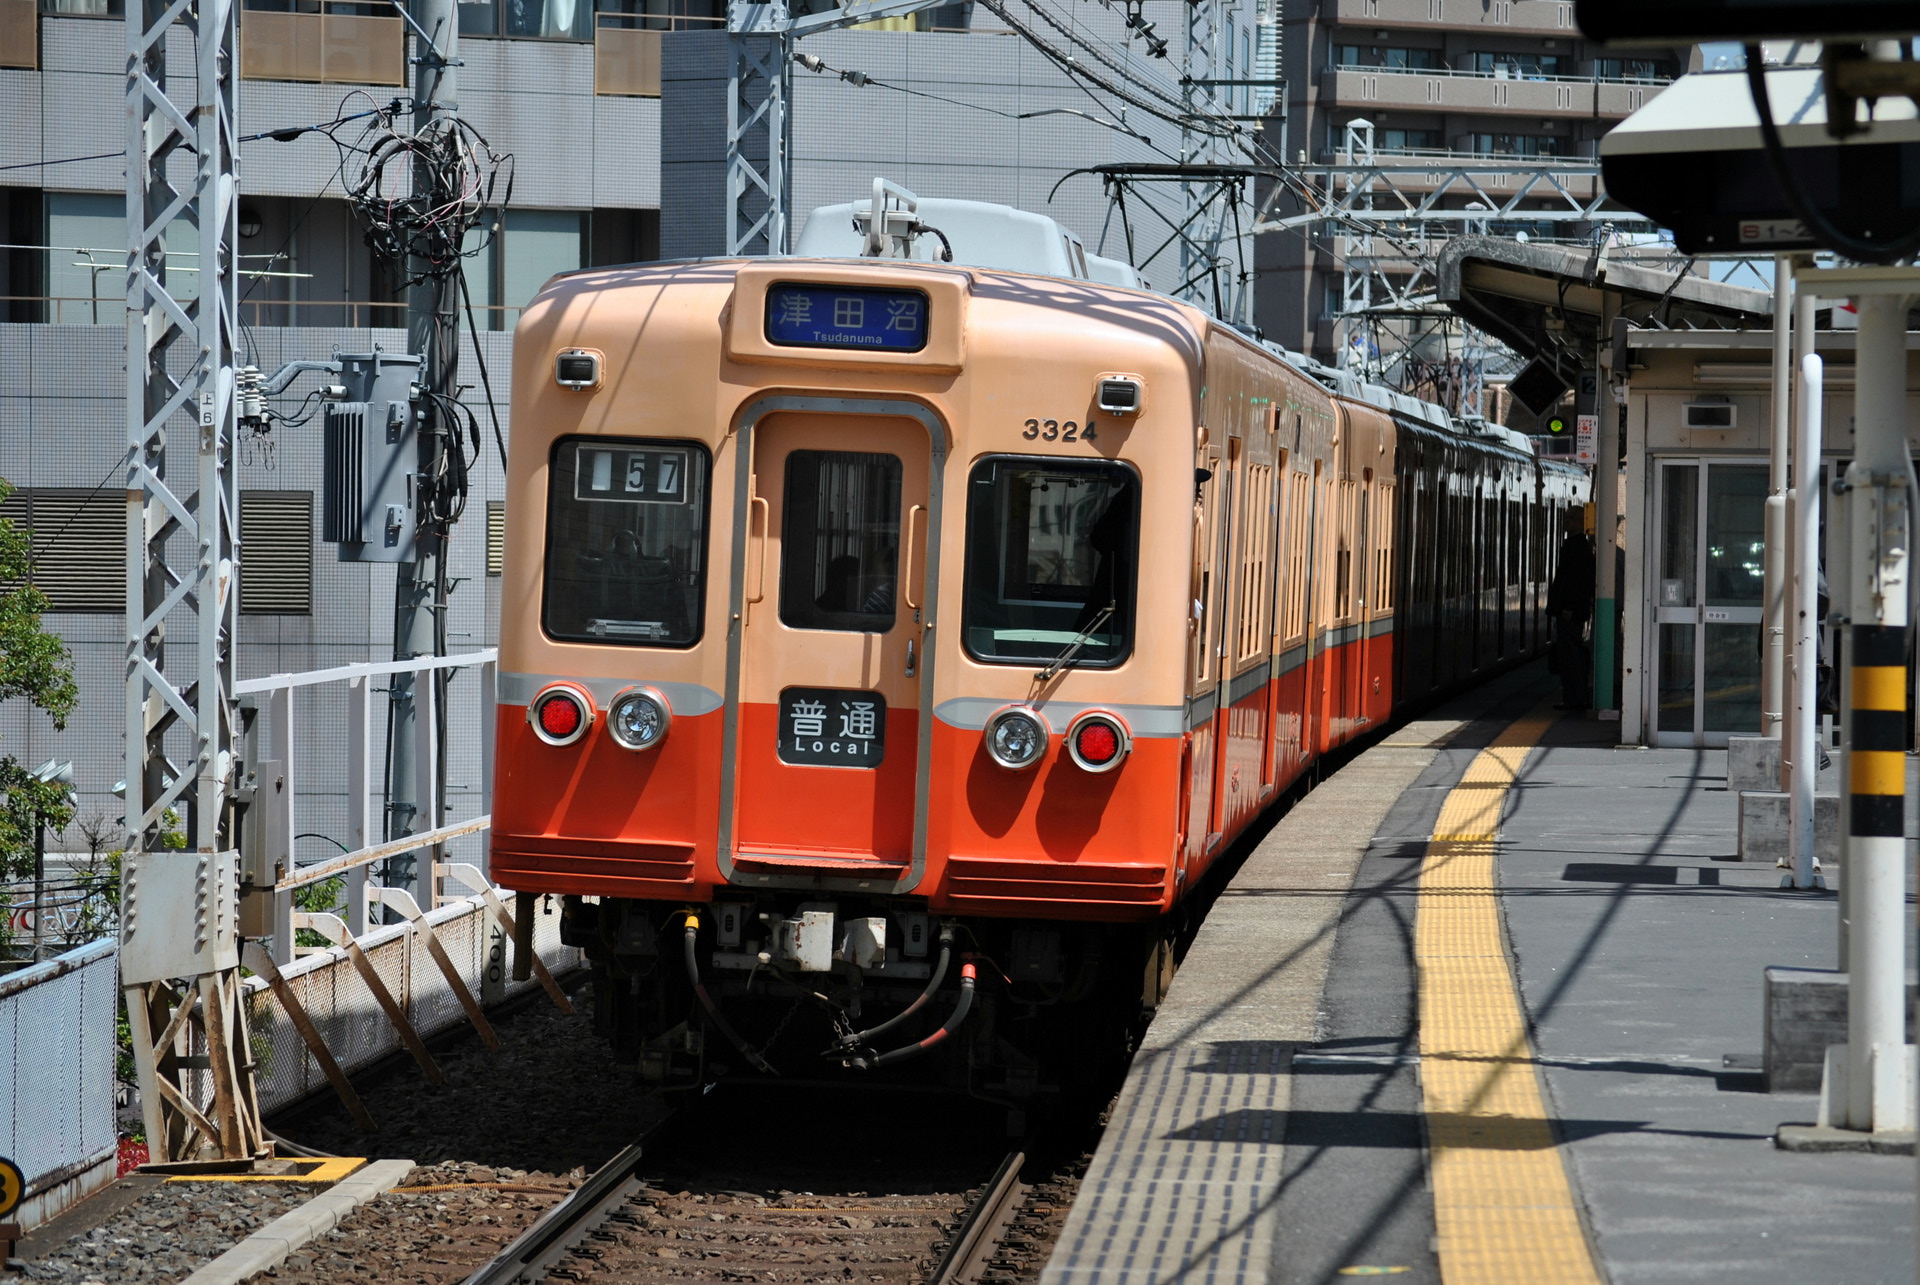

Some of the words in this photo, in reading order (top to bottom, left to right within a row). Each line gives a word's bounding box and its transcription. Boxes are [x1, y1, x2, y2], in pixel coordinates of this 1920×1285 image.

[778, 293, 919, 331] 津田沼
[812, 331, 883, 344] Tsudanuma
[1585, 378, 1596, 392] 2
[1022, 418, 1097, 442] 3324
[790, 698, 876, 740] 普通
[795, 737, 868, 755] Local
[488, 924, 502, 984] 400
